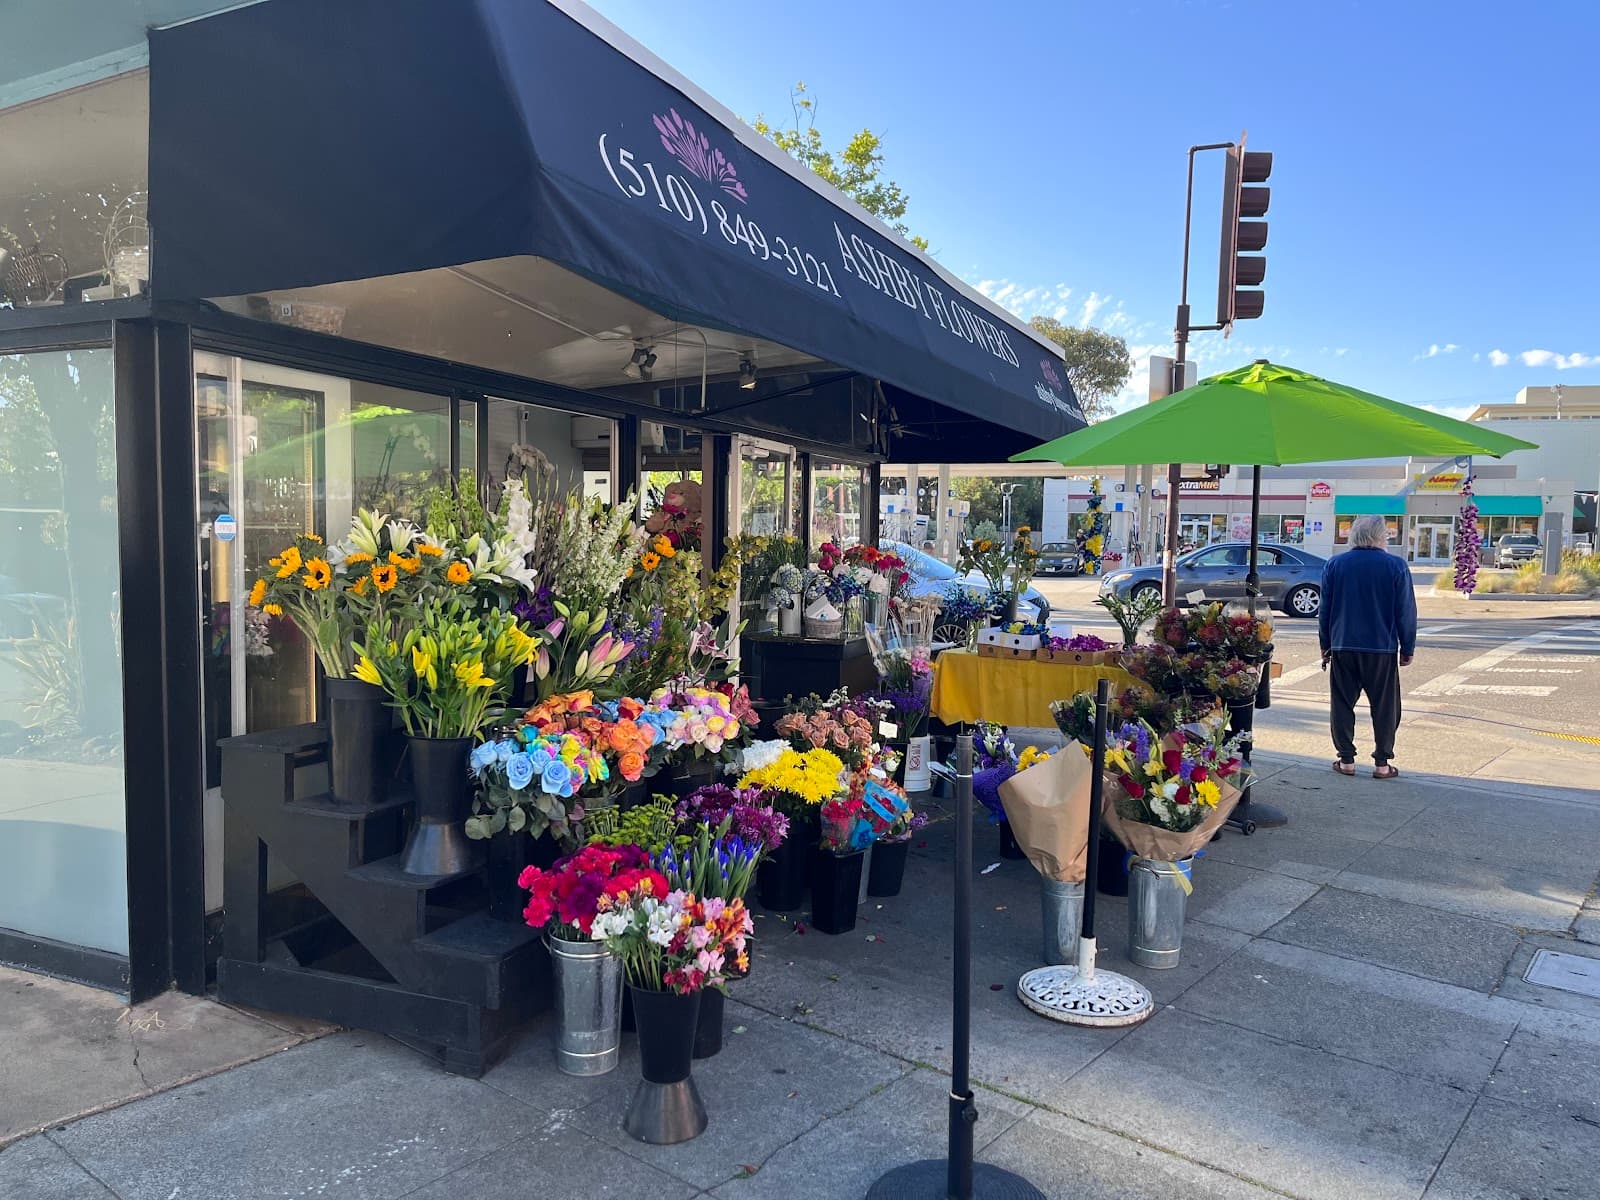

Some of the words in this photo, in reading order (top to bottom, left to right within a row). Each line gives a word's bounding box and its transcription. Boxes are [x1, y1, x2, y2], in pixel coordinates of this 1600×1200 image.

[599, 133, 708, 235] (510)
[711, 200, 842, 298] 849-3121
[833, 221, 932, 319] ASHBY
[922, 282, 1021, 369] FLOWERS
[1179, 481, 1218, 489] xtraMile
